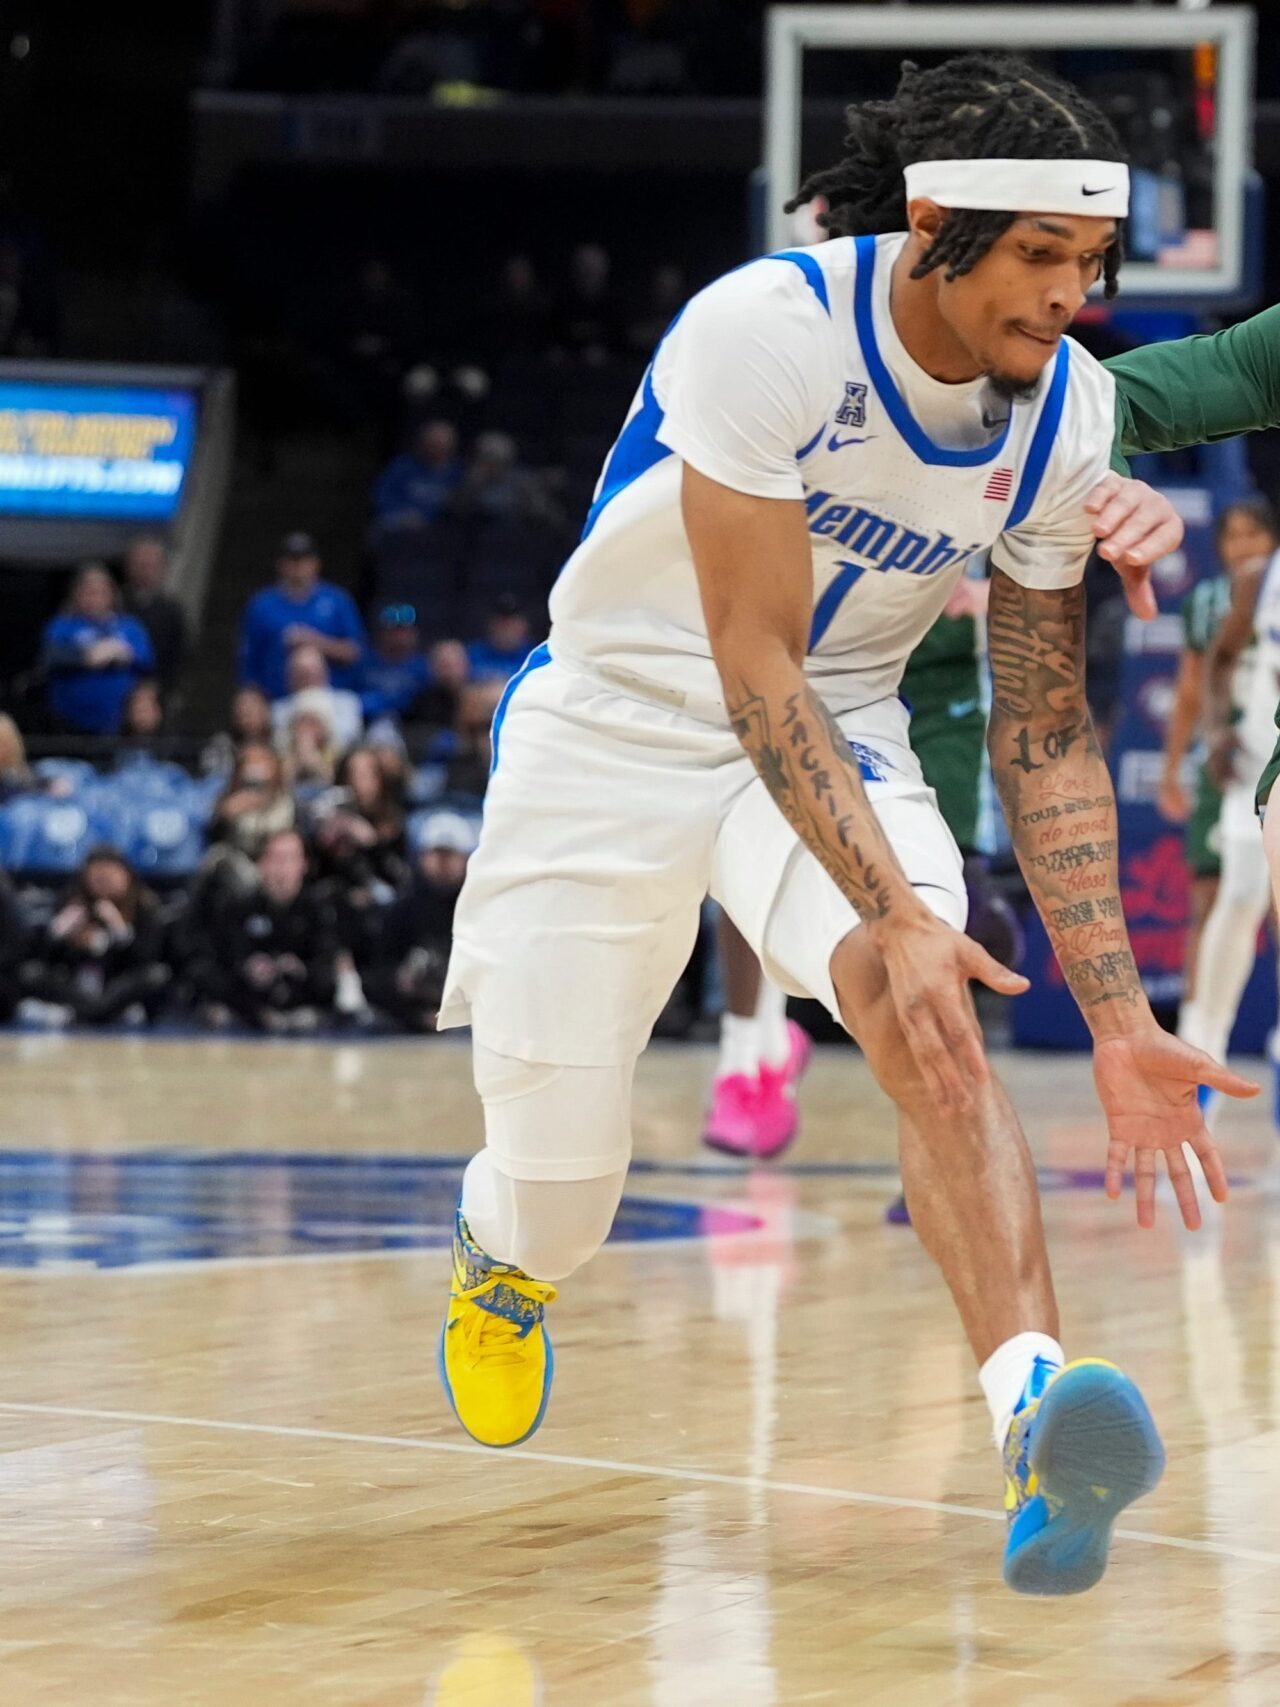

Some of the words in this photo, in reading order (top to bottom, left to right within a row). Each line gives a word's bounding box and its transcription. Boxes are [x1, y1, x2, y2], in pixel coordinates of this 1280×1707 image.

[801, 482, 982, 576] emphi
[804, 560, 868, 656] 1
[1020, 805, 1061, 826] YOUR
